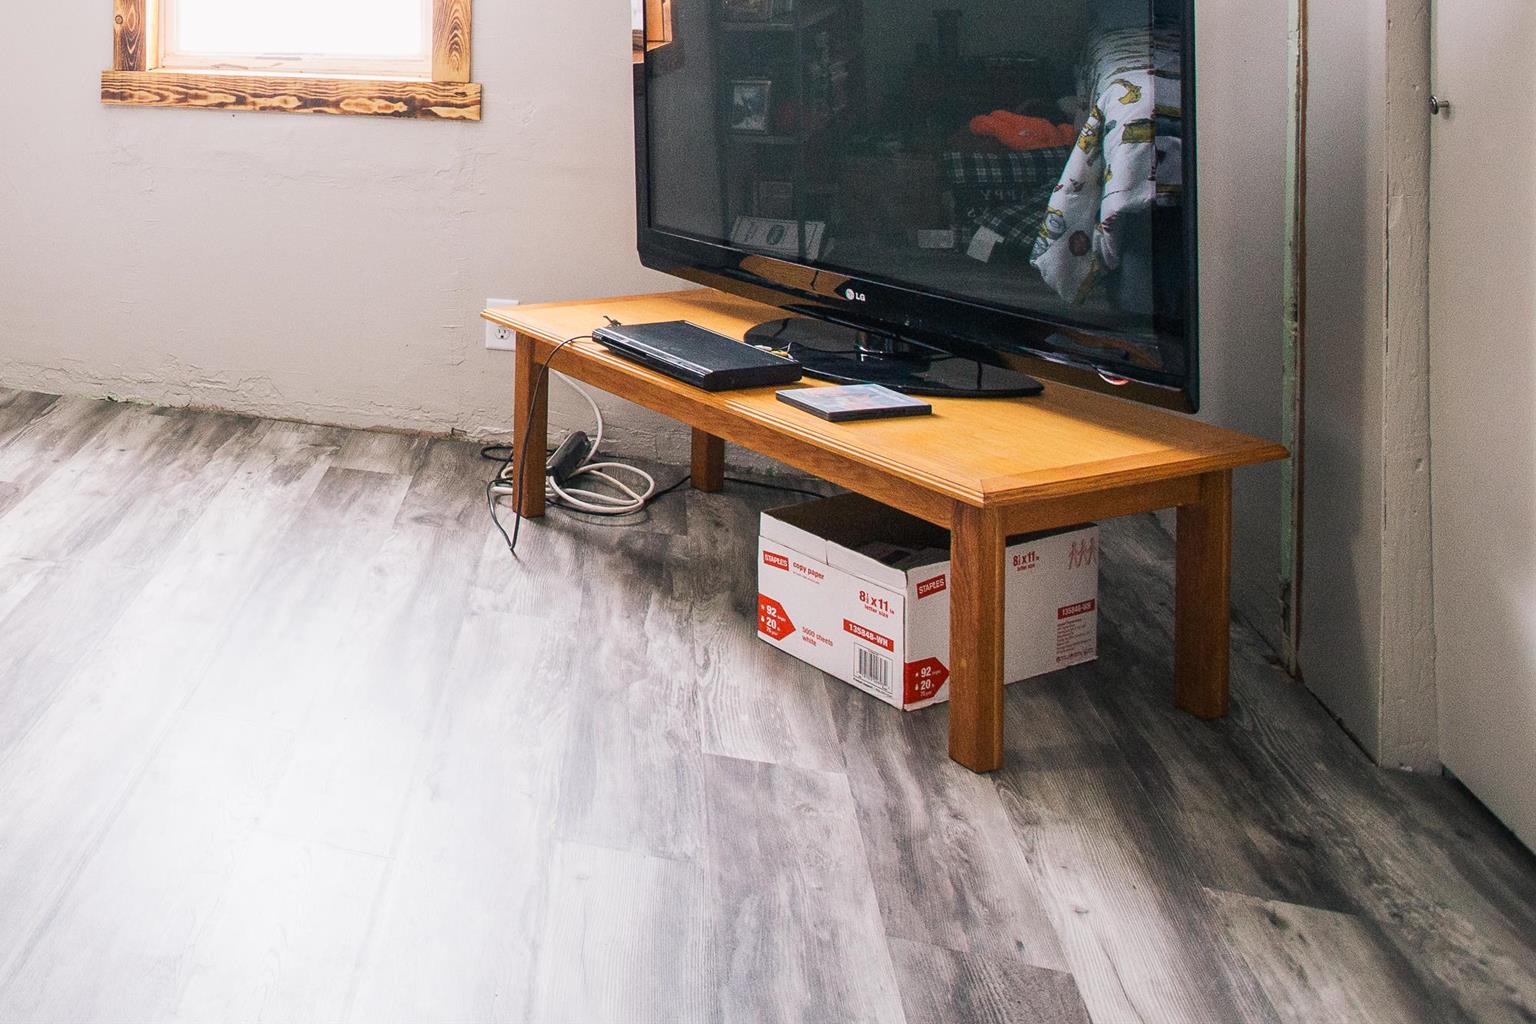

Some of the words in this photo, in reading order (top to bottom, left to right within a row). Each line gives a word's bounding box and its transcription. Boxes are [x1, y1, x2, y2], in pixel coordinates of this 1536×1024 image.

[855, 292, 865, 302] LG
[765, 553, 788, 567] STAPLES
[793, 562, 806, 574] copy
[919, 578, 944, 594] STAPLES
[766, 605, 777, 617] 92
[766, 617, 777, 629] 20
[921, 666, 932, 678] 92
[921, 679, 931, 690] 20
